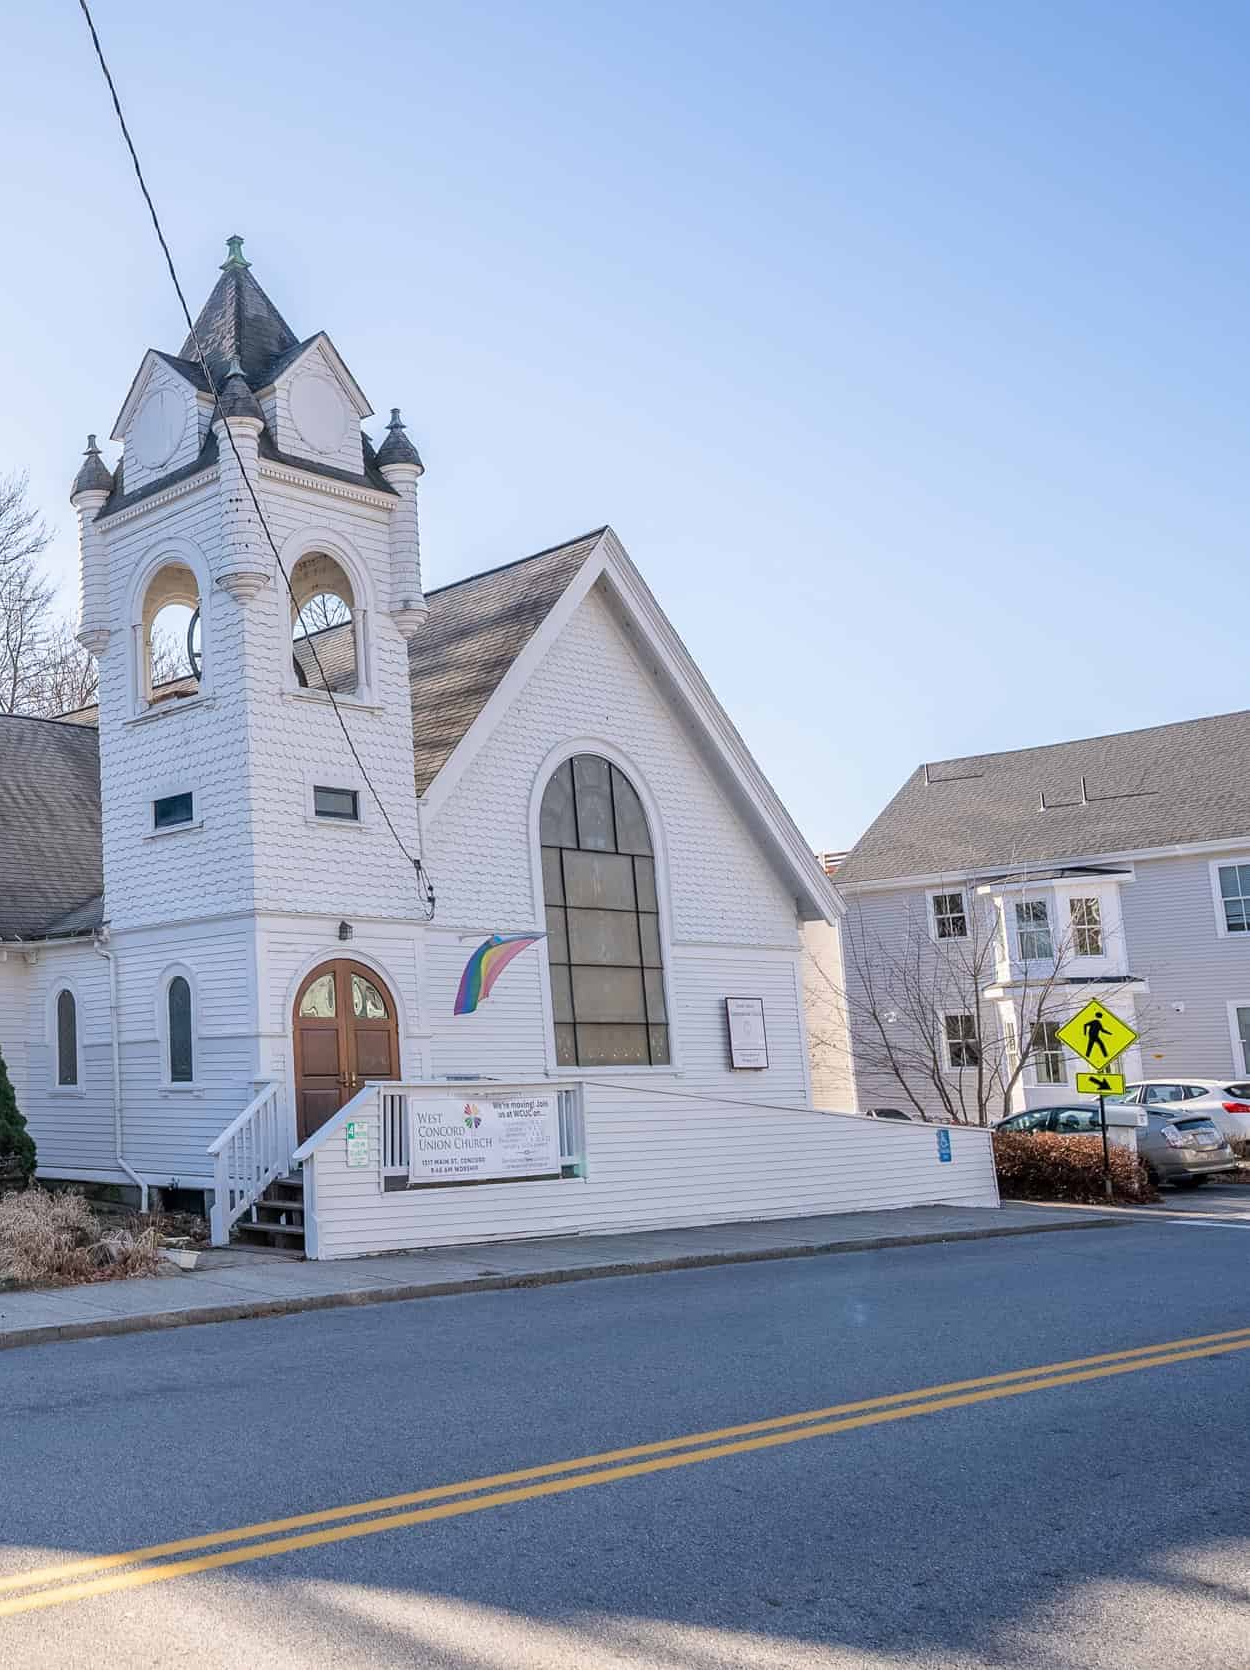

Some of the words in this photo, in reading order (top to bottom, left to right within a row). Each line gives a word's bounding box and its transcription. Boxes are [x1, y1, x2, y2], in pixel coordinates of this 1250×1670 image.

[417, 1112, 443, 1124] WEST
[418, 1126, 465, 1137] CONCORD
[418, 1138, 451, 1151] UNION
[454, 1137, 493, 1149] CHURCH
